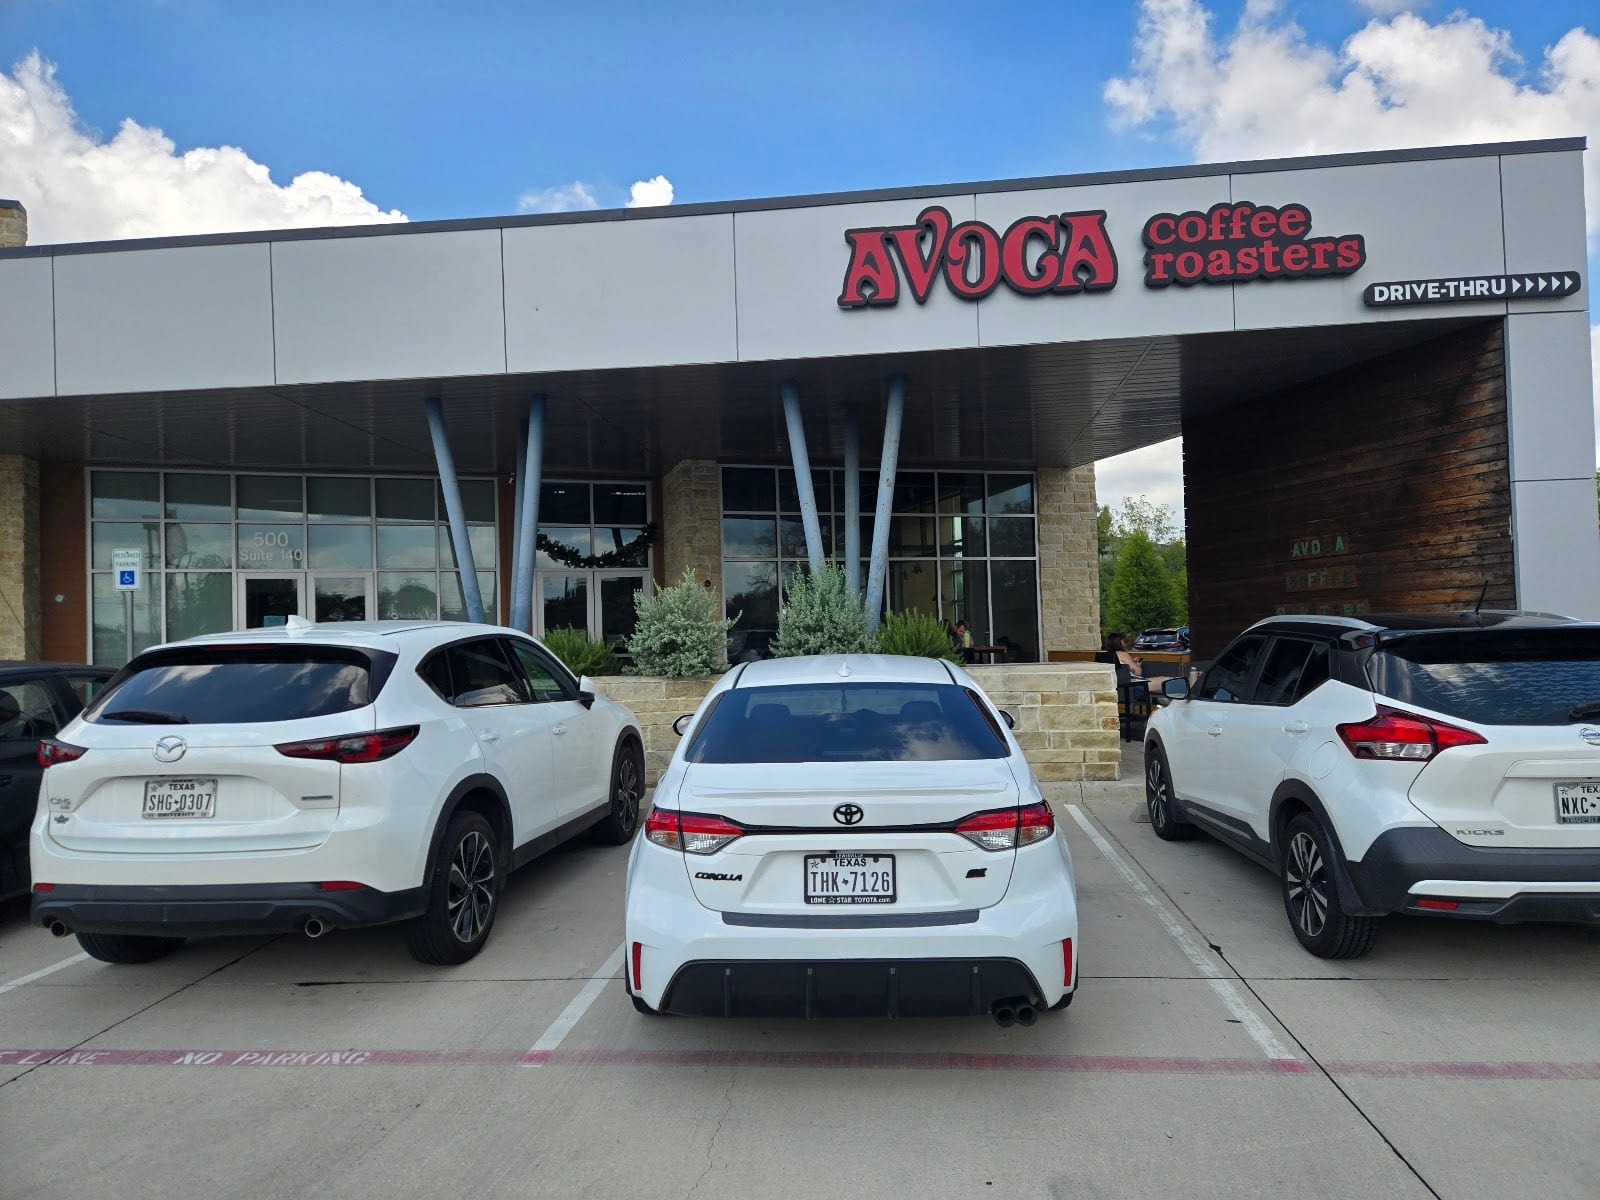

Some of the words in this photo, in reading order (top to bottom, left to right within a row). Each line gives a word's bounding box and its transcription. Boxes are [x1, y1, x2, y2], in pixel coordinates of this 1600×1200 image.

[1149, 206, 1306, 245] coffee
[837, 206, 1117, 309] AVOCA
[1151, 239, 1361, 280] roasters
[1374, 278, 1507, 302] DRIVE-THRU
[254, 531, 289, 547] 500
[240, 549, 273, 561] Suite
[281, 548, 303, 561] 140
[169, 783, 196, 791] TEXAS
[180, 793, 212, 811] 0307
[1561, 796, 1589, 815] NXC
[832, 858, 867, 867] TEXAS
[694, 871, 743, 882] COROLLA
[810, 871, 840, 893] THK
[849, 871, 890, 893] 7126
[810, 896, 827, 904] LONE
[836, 896, 852, 904] STAR
[172, 1052, 223, 1065] NO
[231, 1052, 370, 1065] PARKING
